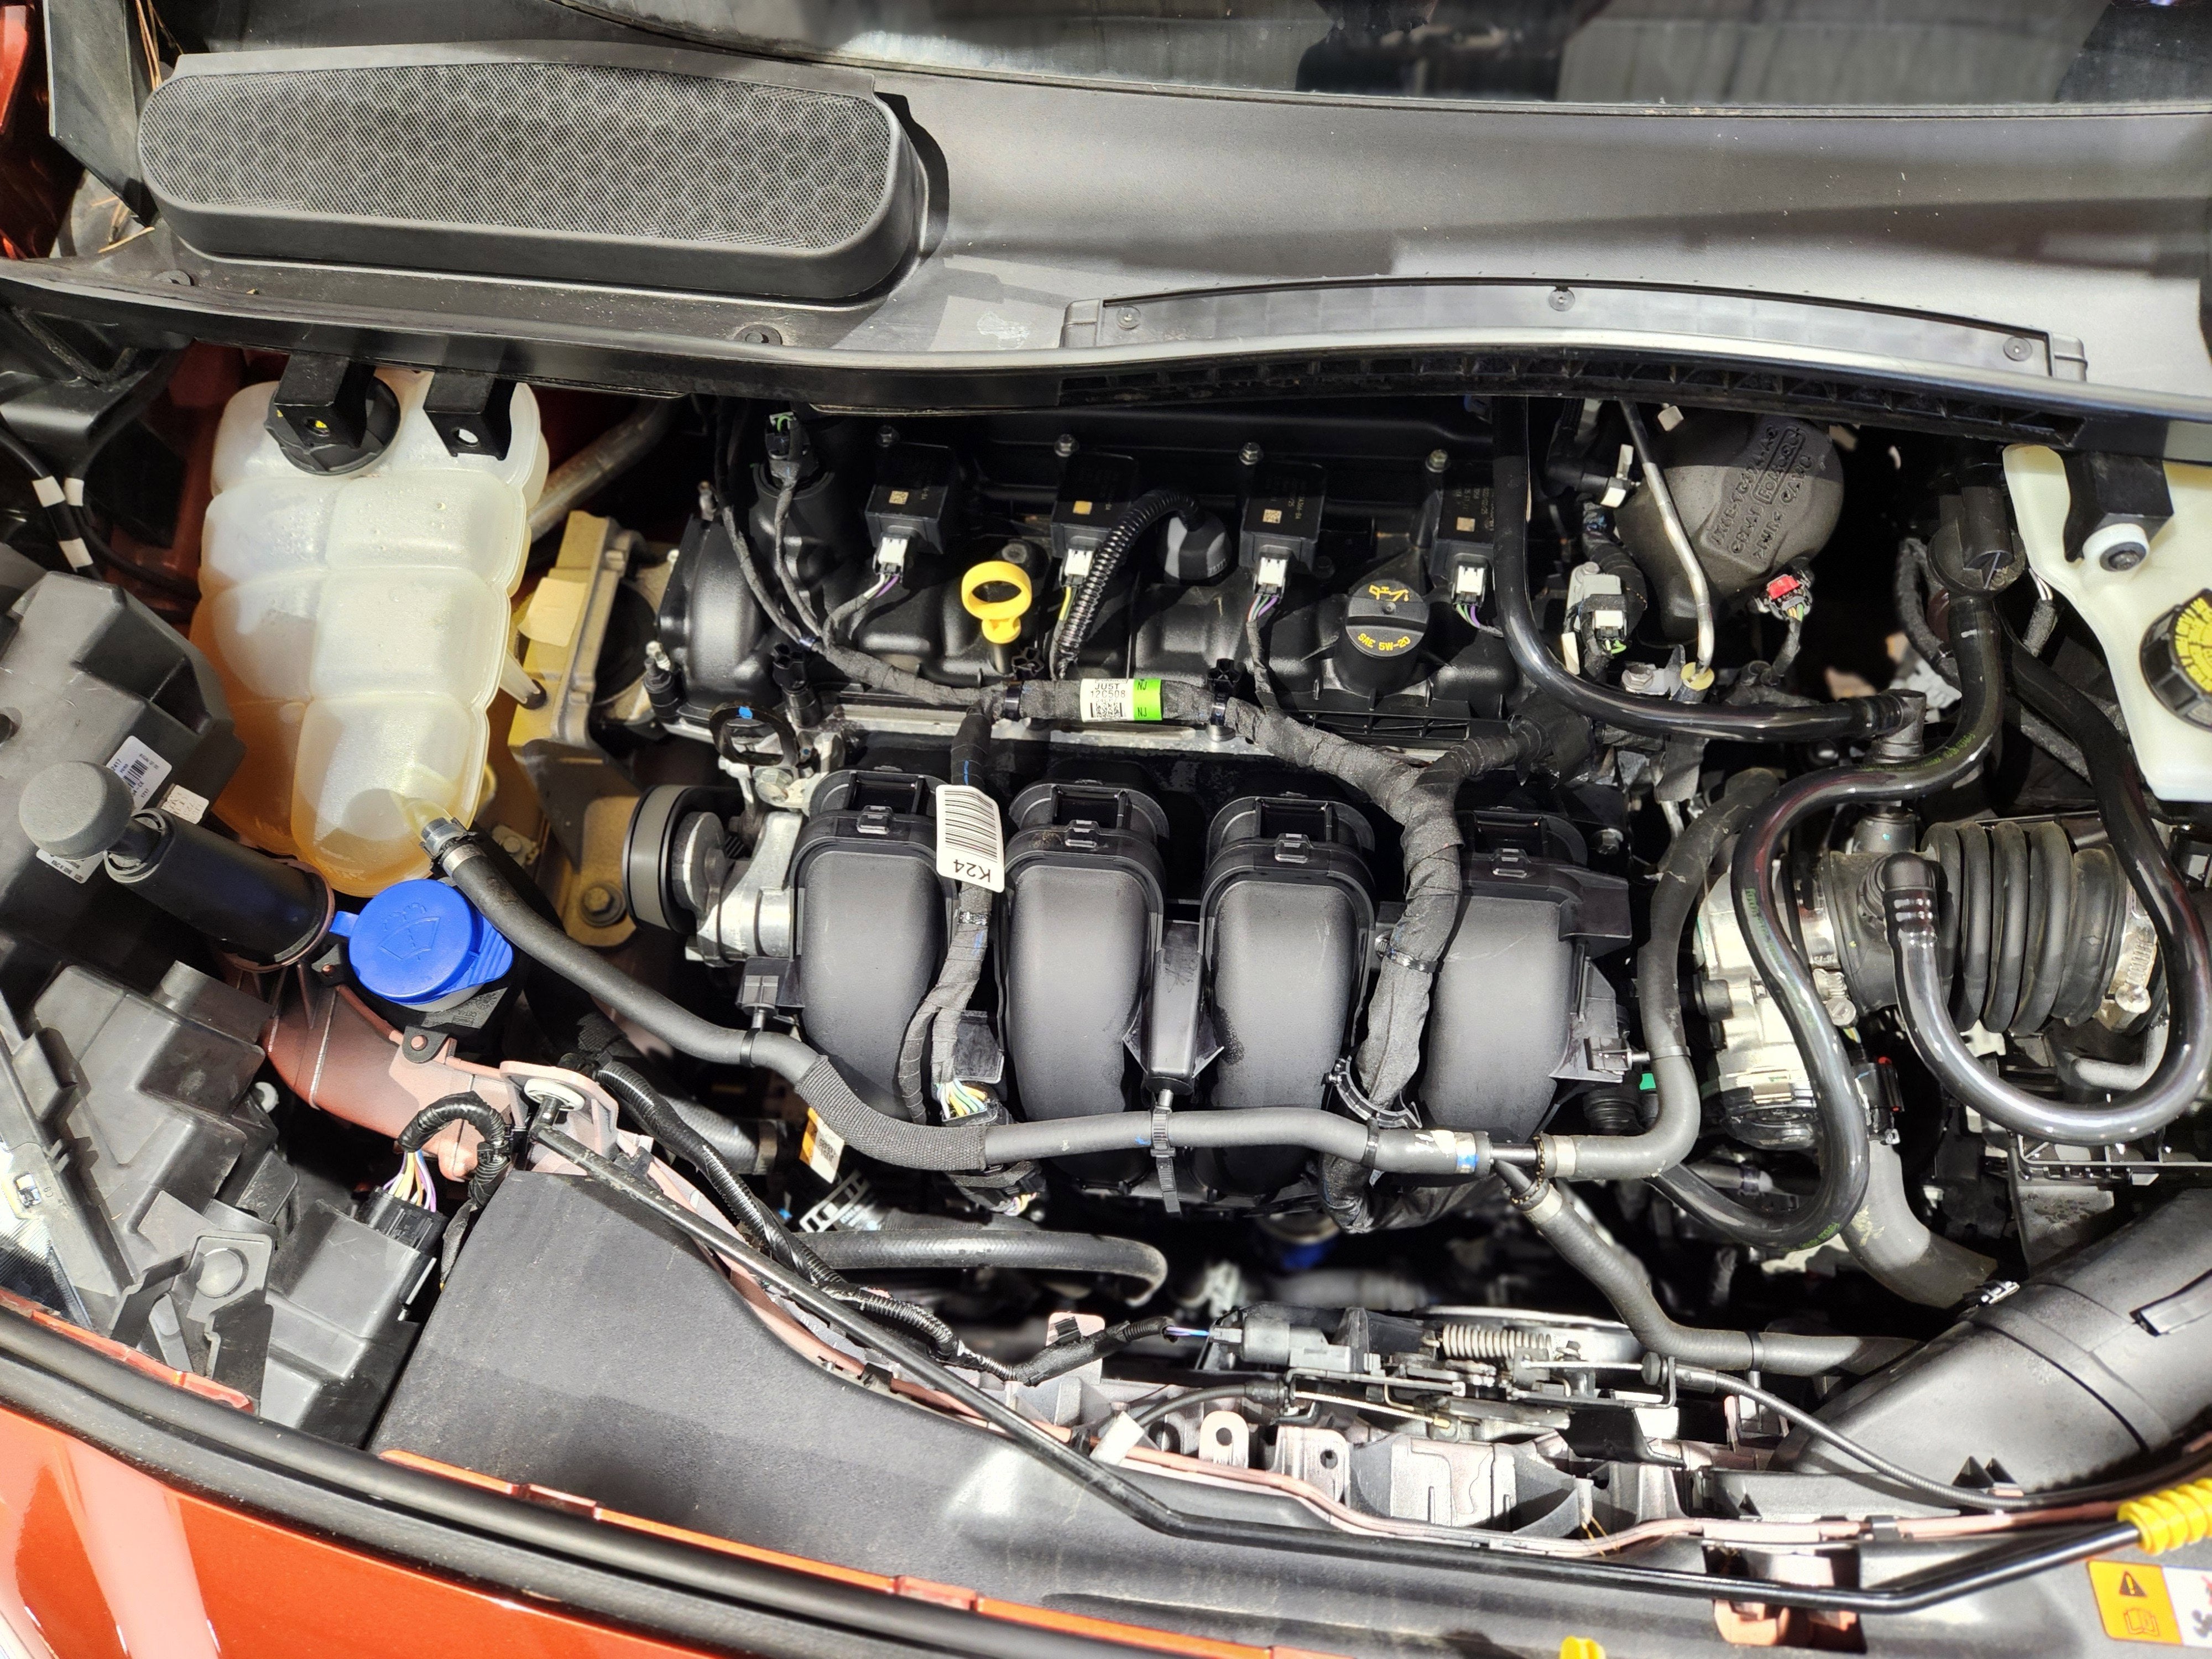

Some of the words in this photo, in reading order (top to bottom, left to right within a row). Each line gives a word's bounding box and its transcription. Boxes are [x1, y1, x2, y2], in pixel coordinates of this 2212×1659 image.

[1358, 633, 1376, 648] SAE
[1379, 635, 1411, 651] 5W-20
[1137, 680, 1147, 690] NJ
[1090, 690, 1125, 698] 12C508
[1138, 707, 1147, 717] NJ
[953, 859, 991, 883] K24
